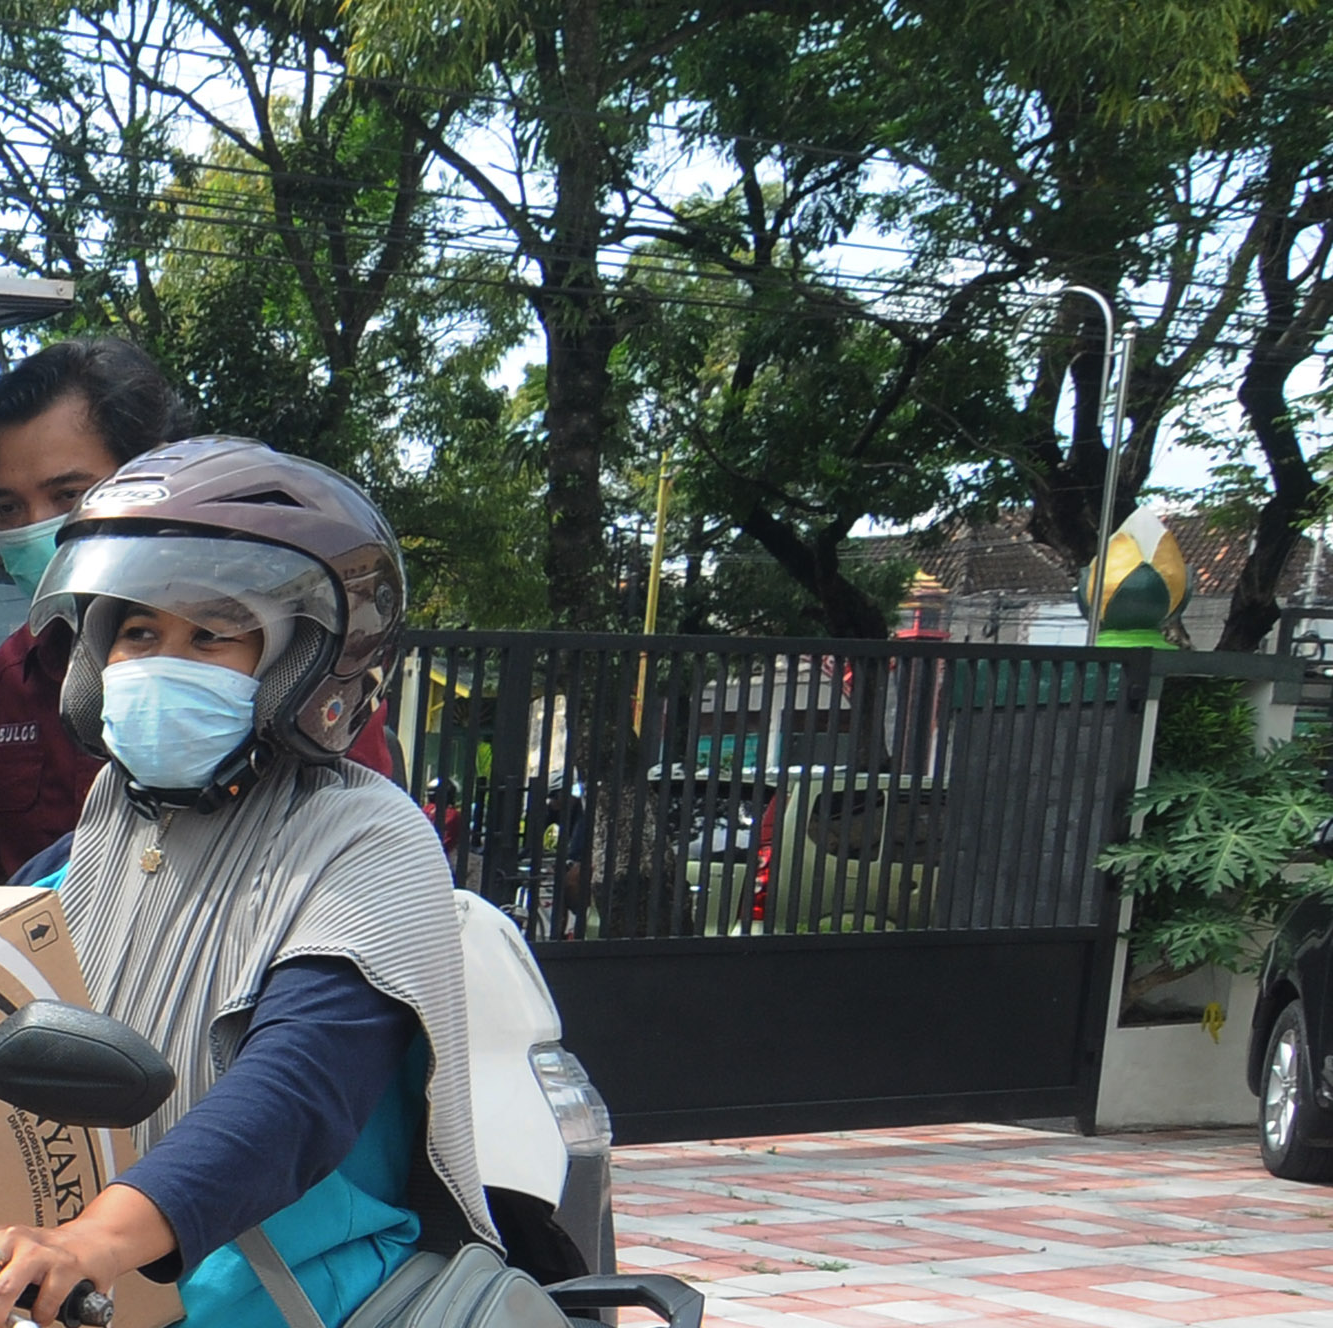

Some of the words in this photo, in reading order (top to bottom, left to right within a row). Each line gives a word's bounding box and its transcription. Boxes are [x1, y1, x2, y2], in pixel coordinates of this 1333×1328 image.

[7, 1114, 38, 1186] DIFORTIFIKASI
[23, 1125, 44, 1167] GORENG
[38, 1166, 52, 1199] SAWIT
